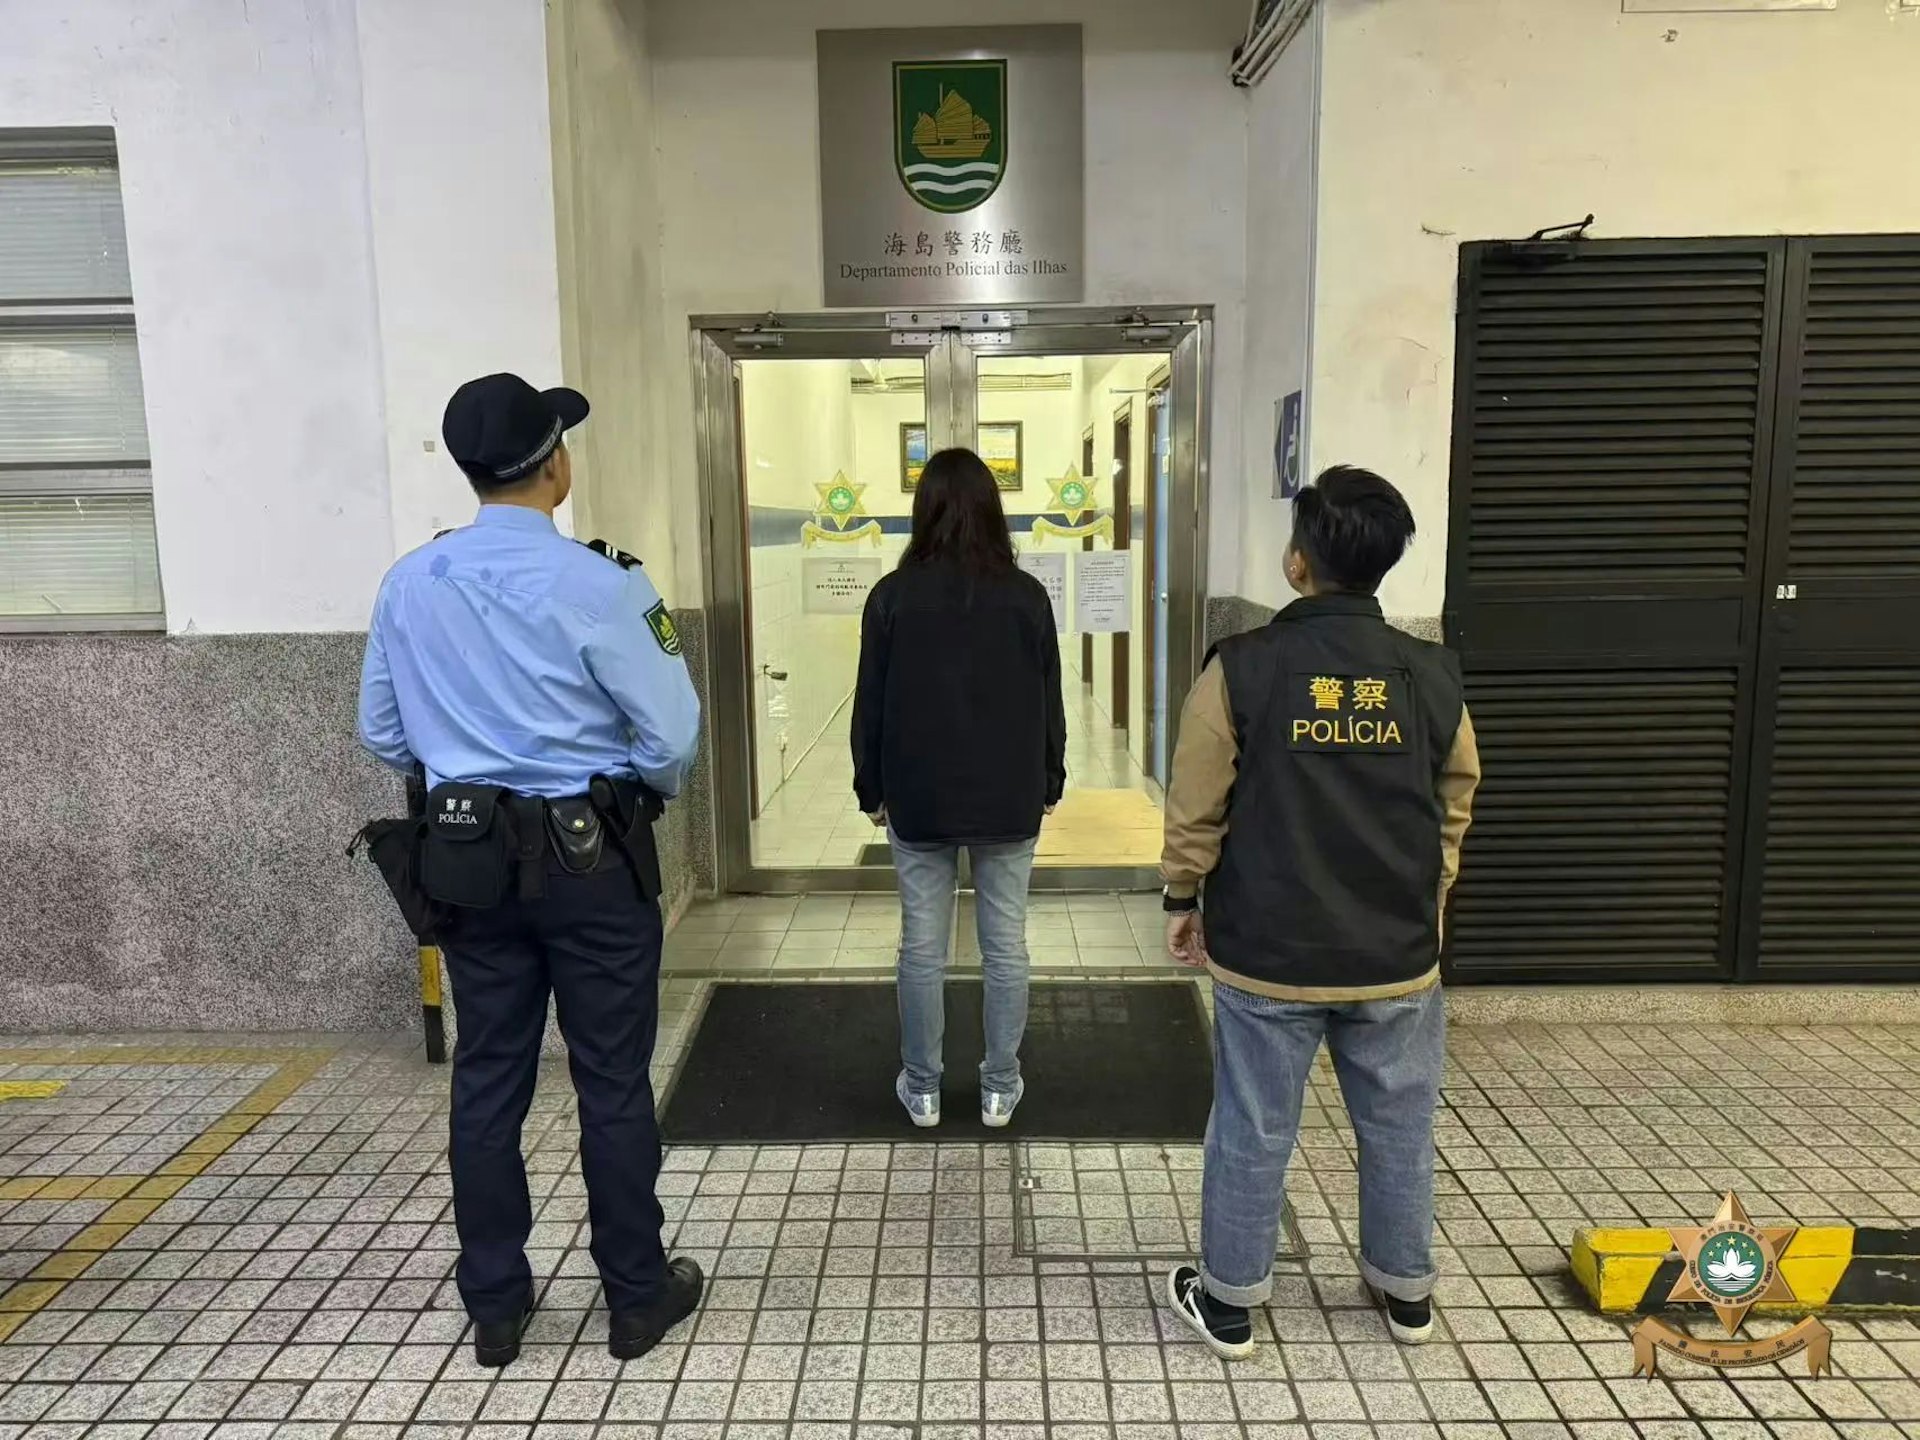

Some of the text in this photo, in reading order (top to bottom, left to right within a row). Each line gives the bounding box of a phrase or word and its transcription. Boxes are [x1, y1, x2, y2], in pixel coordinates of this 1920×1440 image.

[884, 229, 1023, 257] 海島警務廳
[840, 259, 1068, 282] Departamento Policial das Ilhas
[1309, 676, 1388, 710] 警察
[1292, 715, 1402, 744] POLÍCIA
[438, 811, 478, 824] POLÍCIA
